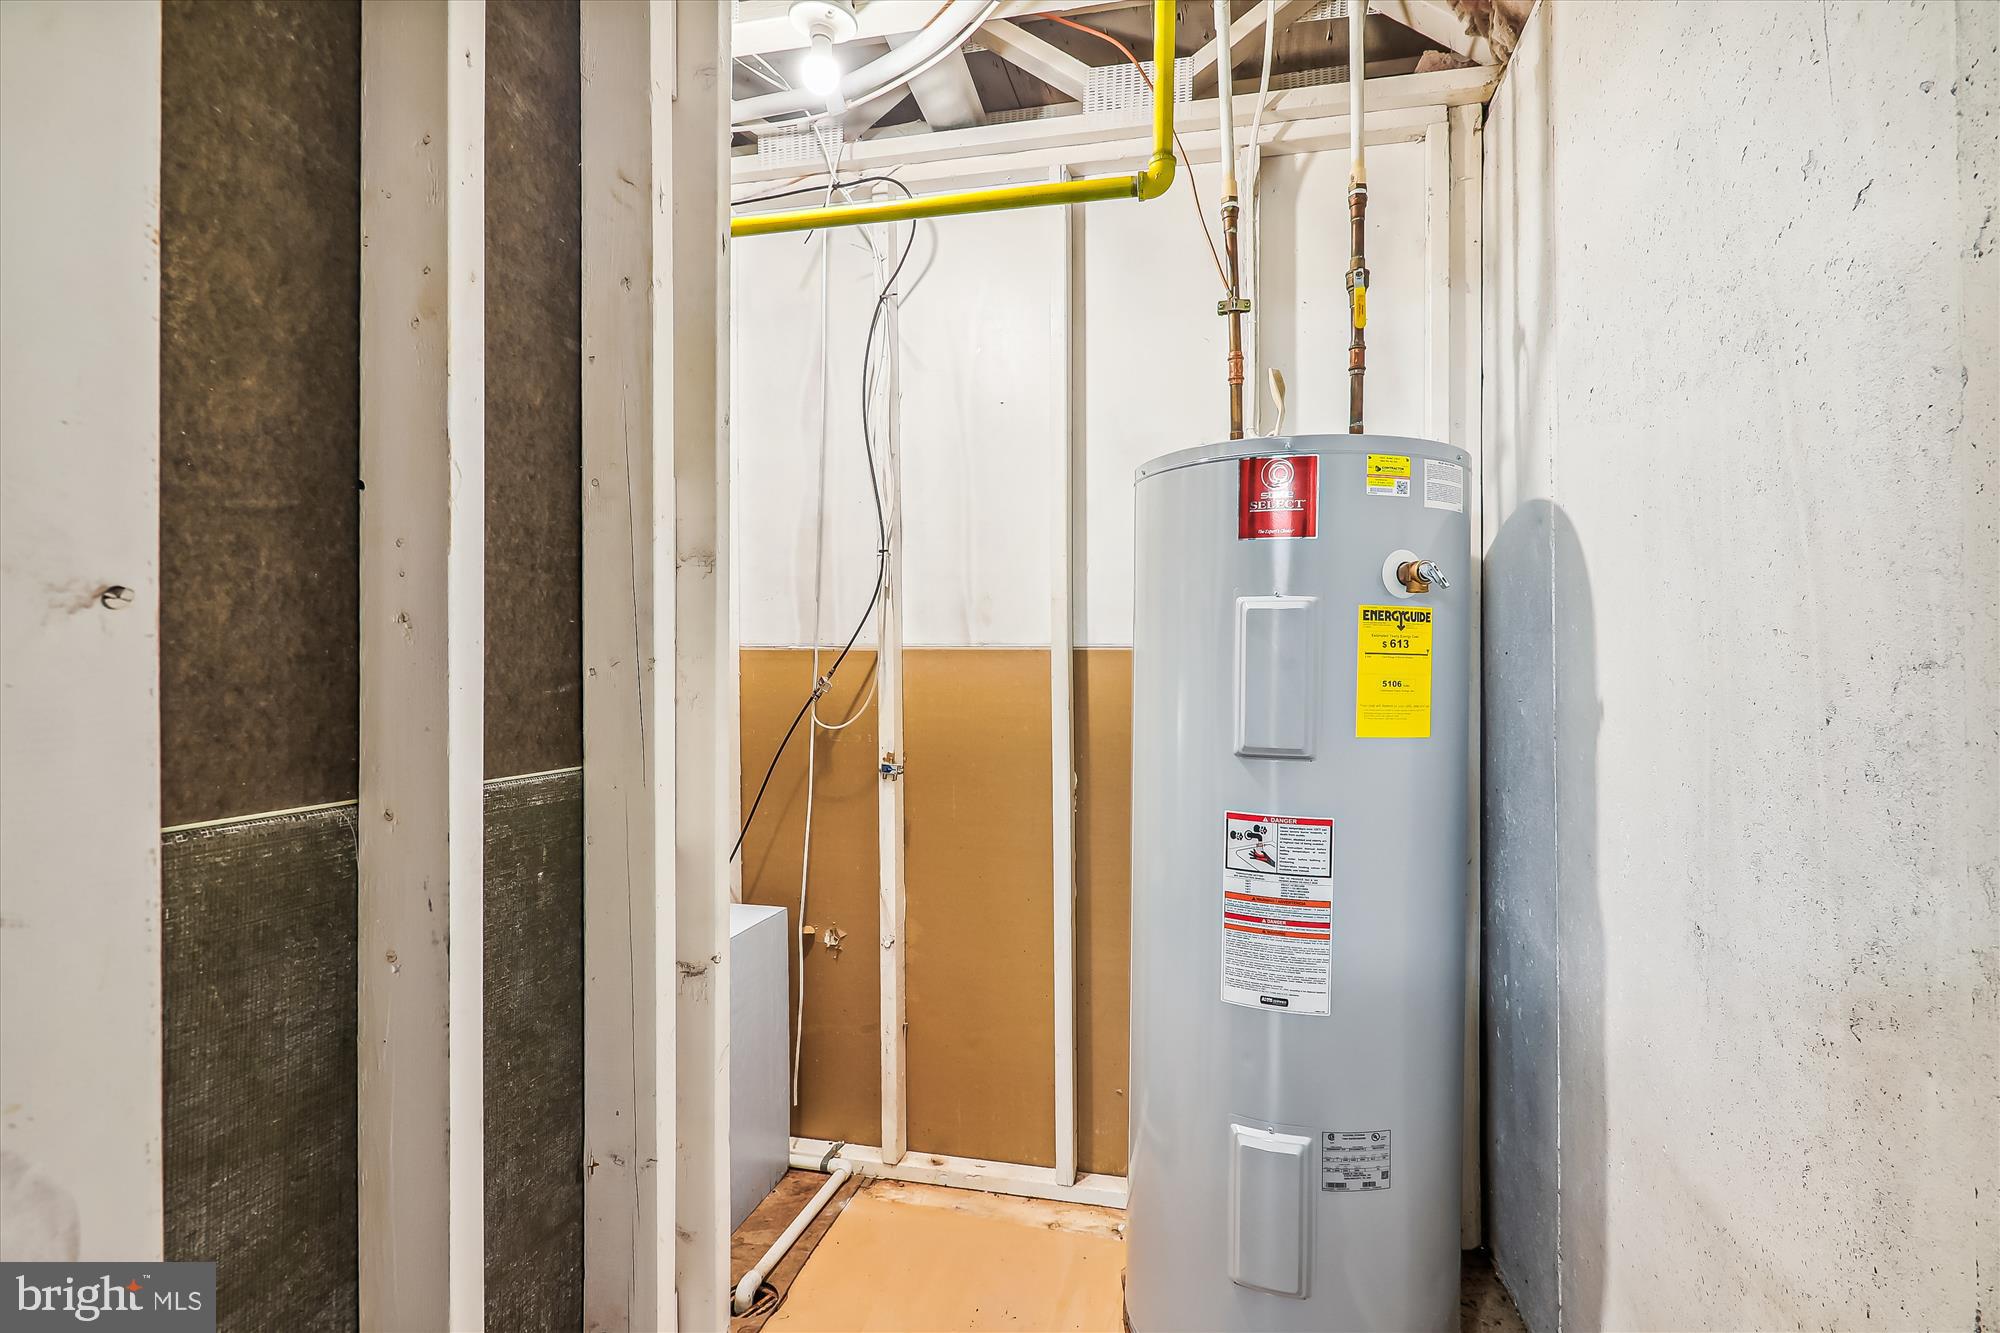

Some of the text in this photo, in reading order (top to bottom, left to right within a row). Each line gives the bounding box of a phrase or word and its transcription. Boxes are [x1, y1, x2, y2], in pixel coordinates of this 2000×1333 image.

[1250, 499, 1304, 511] SELECT
[1362, 609, 1431, 623] ENERGYGUIDE
[1389, 638, 1409, 649] 613
[1382, 680, 1402, 688] 5106
